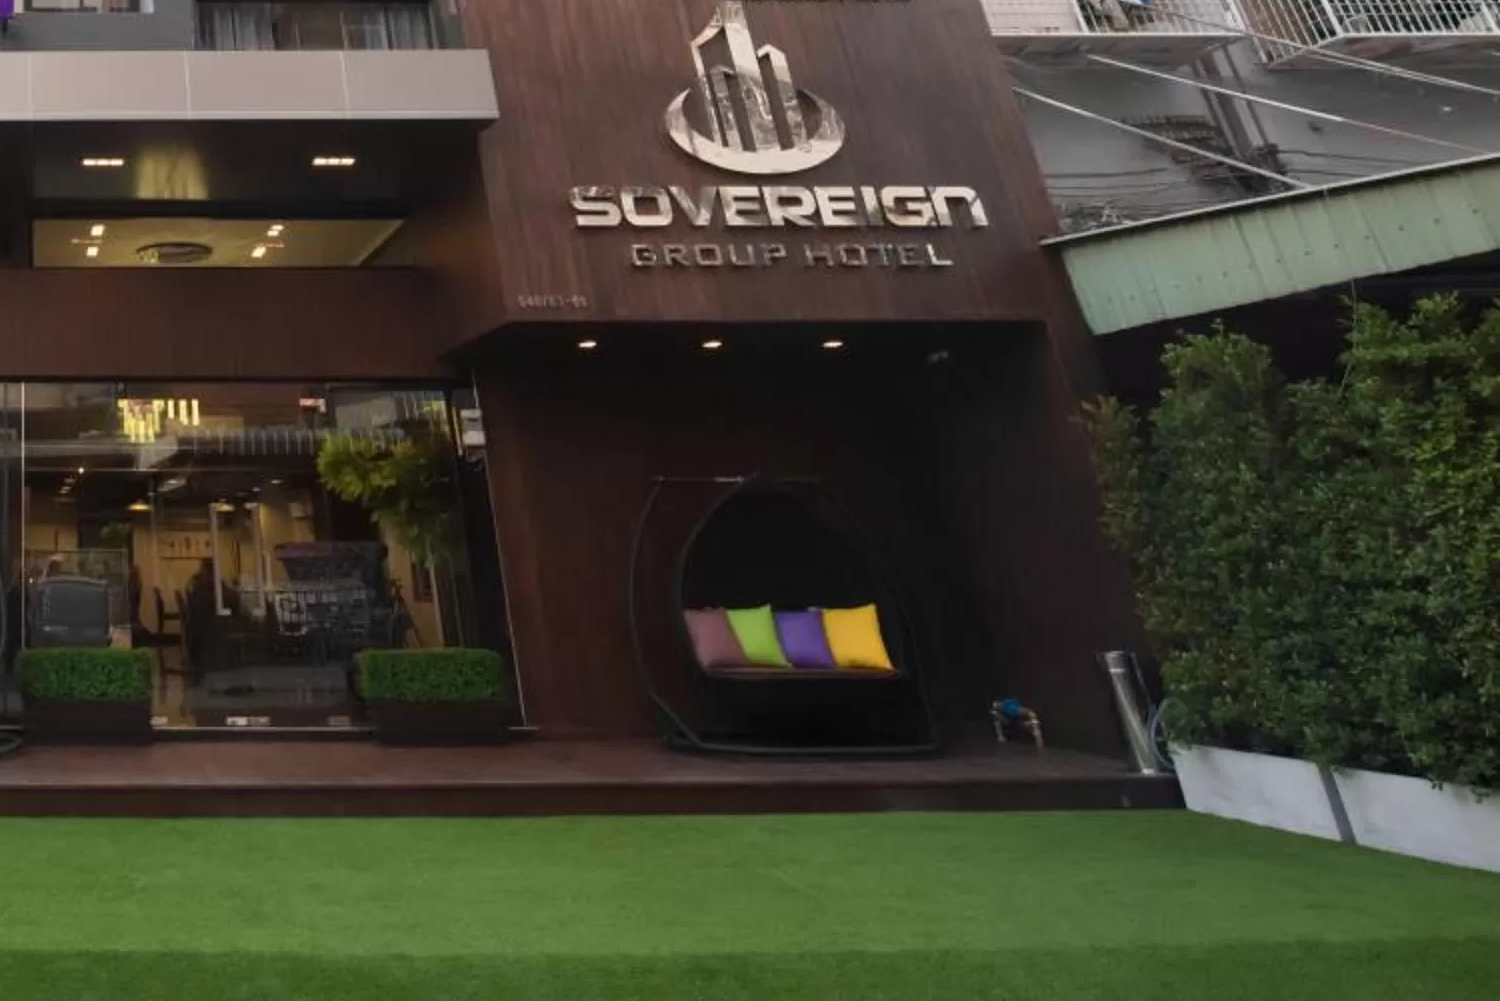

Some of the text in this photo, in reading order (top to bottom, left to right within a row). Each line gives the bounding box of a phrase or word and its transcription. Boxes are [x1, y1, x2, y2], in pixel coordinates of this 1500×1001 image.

[570, 185, 990, 228] SOVEREIGN
[631, 243, 954, 267] GROUP HOTEL
